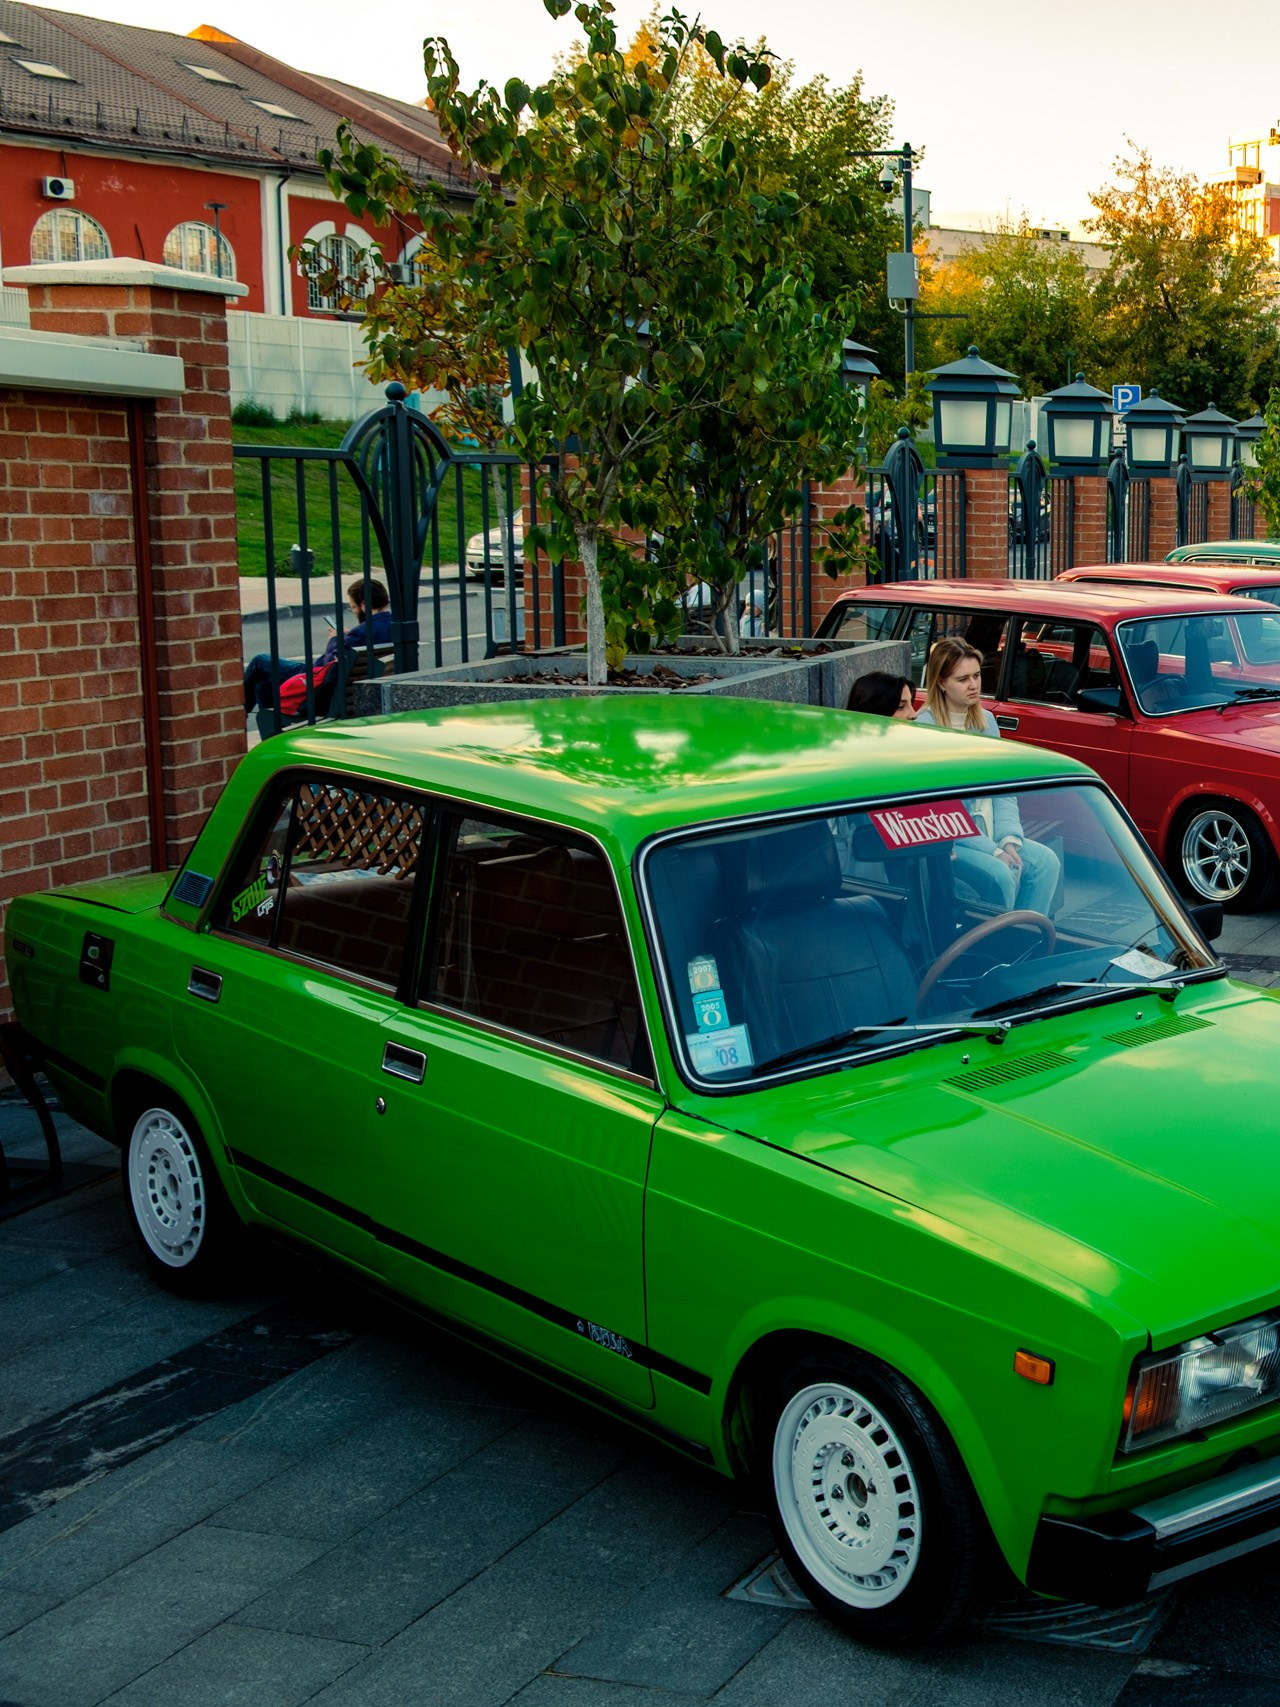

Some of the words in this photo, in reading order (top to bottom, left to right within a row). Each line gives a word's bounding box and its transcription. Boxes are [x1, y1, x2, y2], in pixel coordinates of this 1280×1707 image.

[874, 808, 975, 846] Winston
[692, 965, 712, 974] 2007
[700, 1002, 720, 1012] 2005
